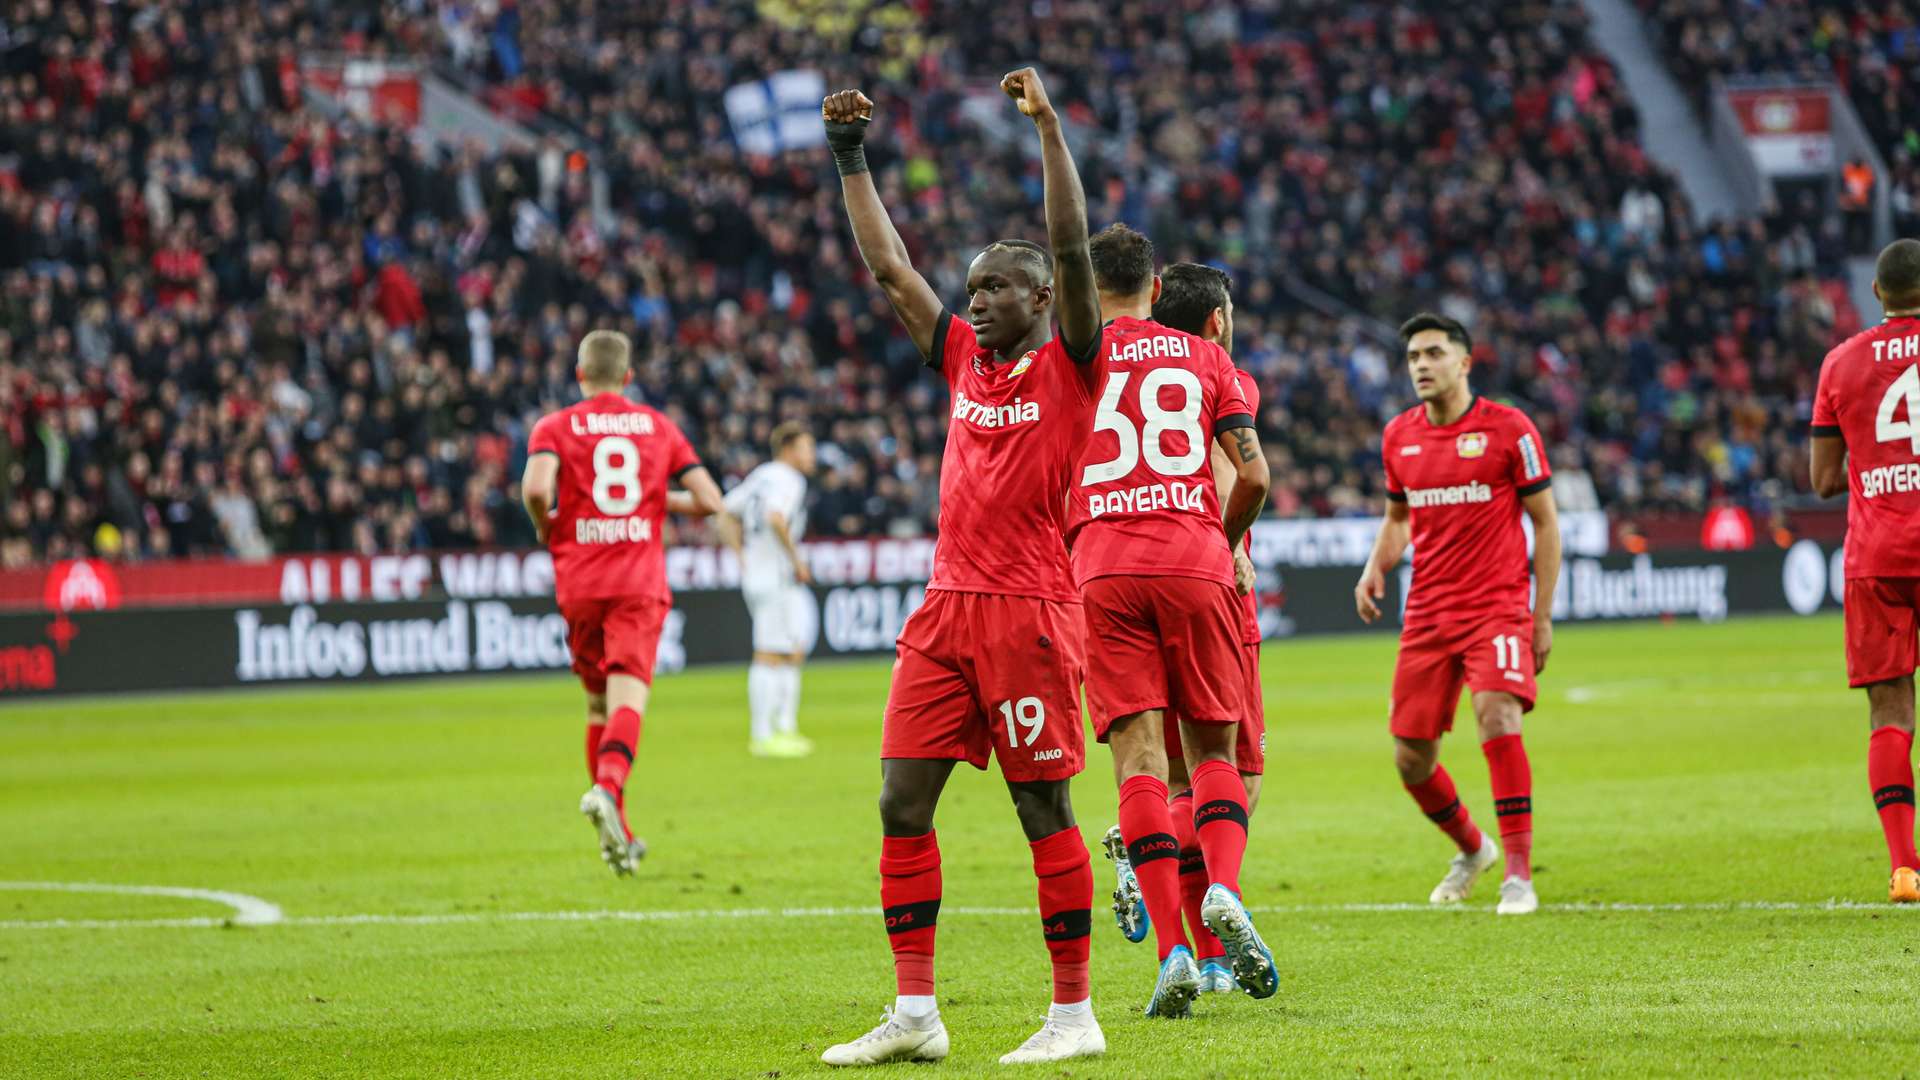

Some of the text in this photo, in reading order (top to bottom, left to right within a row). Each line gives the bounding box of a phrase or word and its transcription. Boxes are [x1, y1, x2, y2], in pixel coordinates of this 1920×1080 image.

[1109, 335, 1190, 362] LARABI
[592, 436, 642, 516] 8
[1088, 482, 1205, 518] BAYER 04
[235, 604, 367, 682] Infos
[370, 601, 469, 675] und
[1492, 634, 1521, 670] 11
[999, 696, 1045, 748] 19
[1033, 748, 1063, 762] JAKO
[1139, 841, 1176, 856] JAKO
